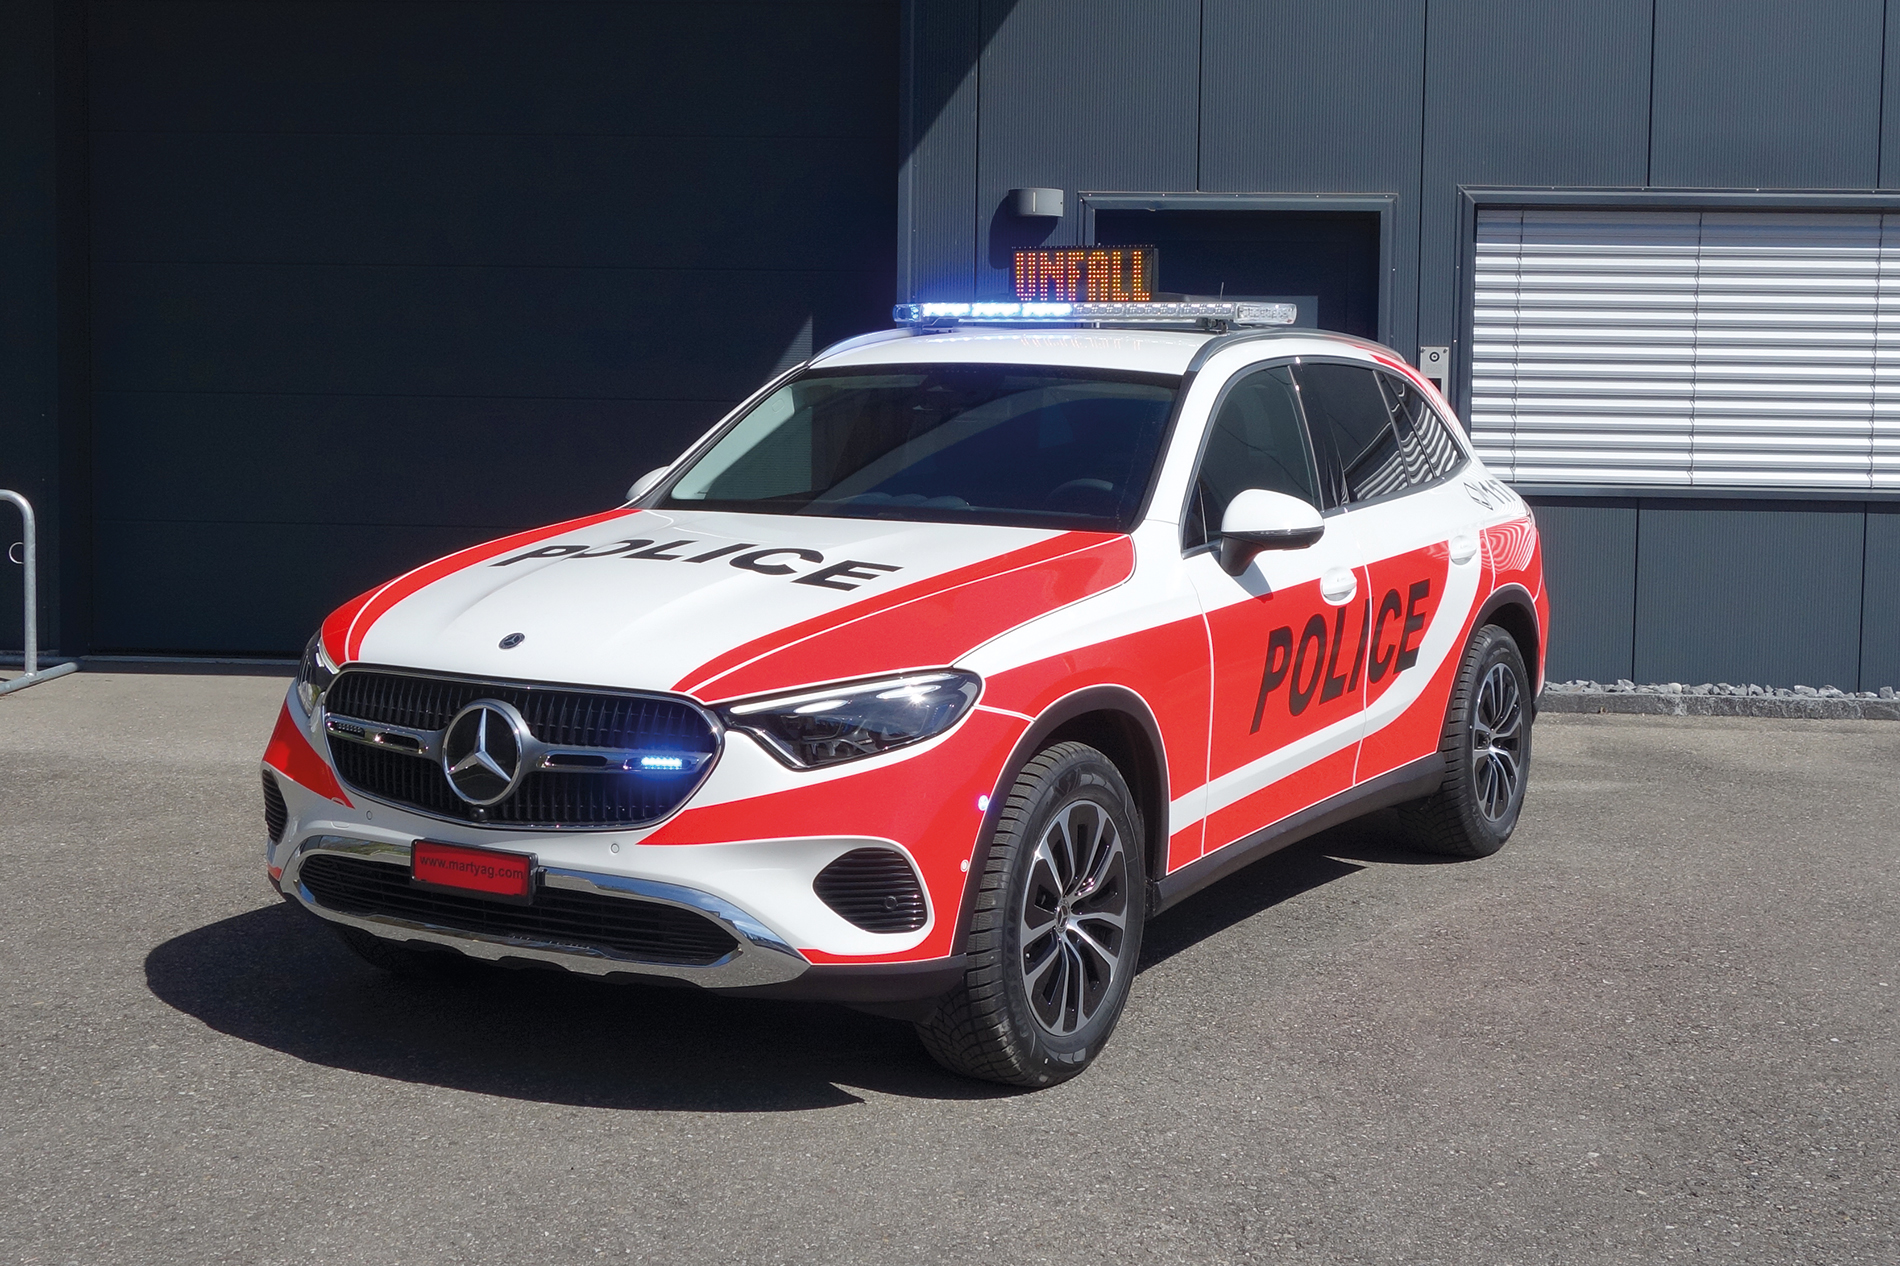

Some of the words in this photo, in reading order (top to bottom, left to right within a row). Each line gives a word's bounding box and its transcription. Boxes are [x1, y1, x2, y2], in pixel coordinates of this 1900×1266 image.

[1015, 251, 1150, 301] UNFALL
[488, 539, 904, 591] POLICE
[1249, 578, 1430, 735] POLICE
[420, 855, 524, 879] www.martyag.com
